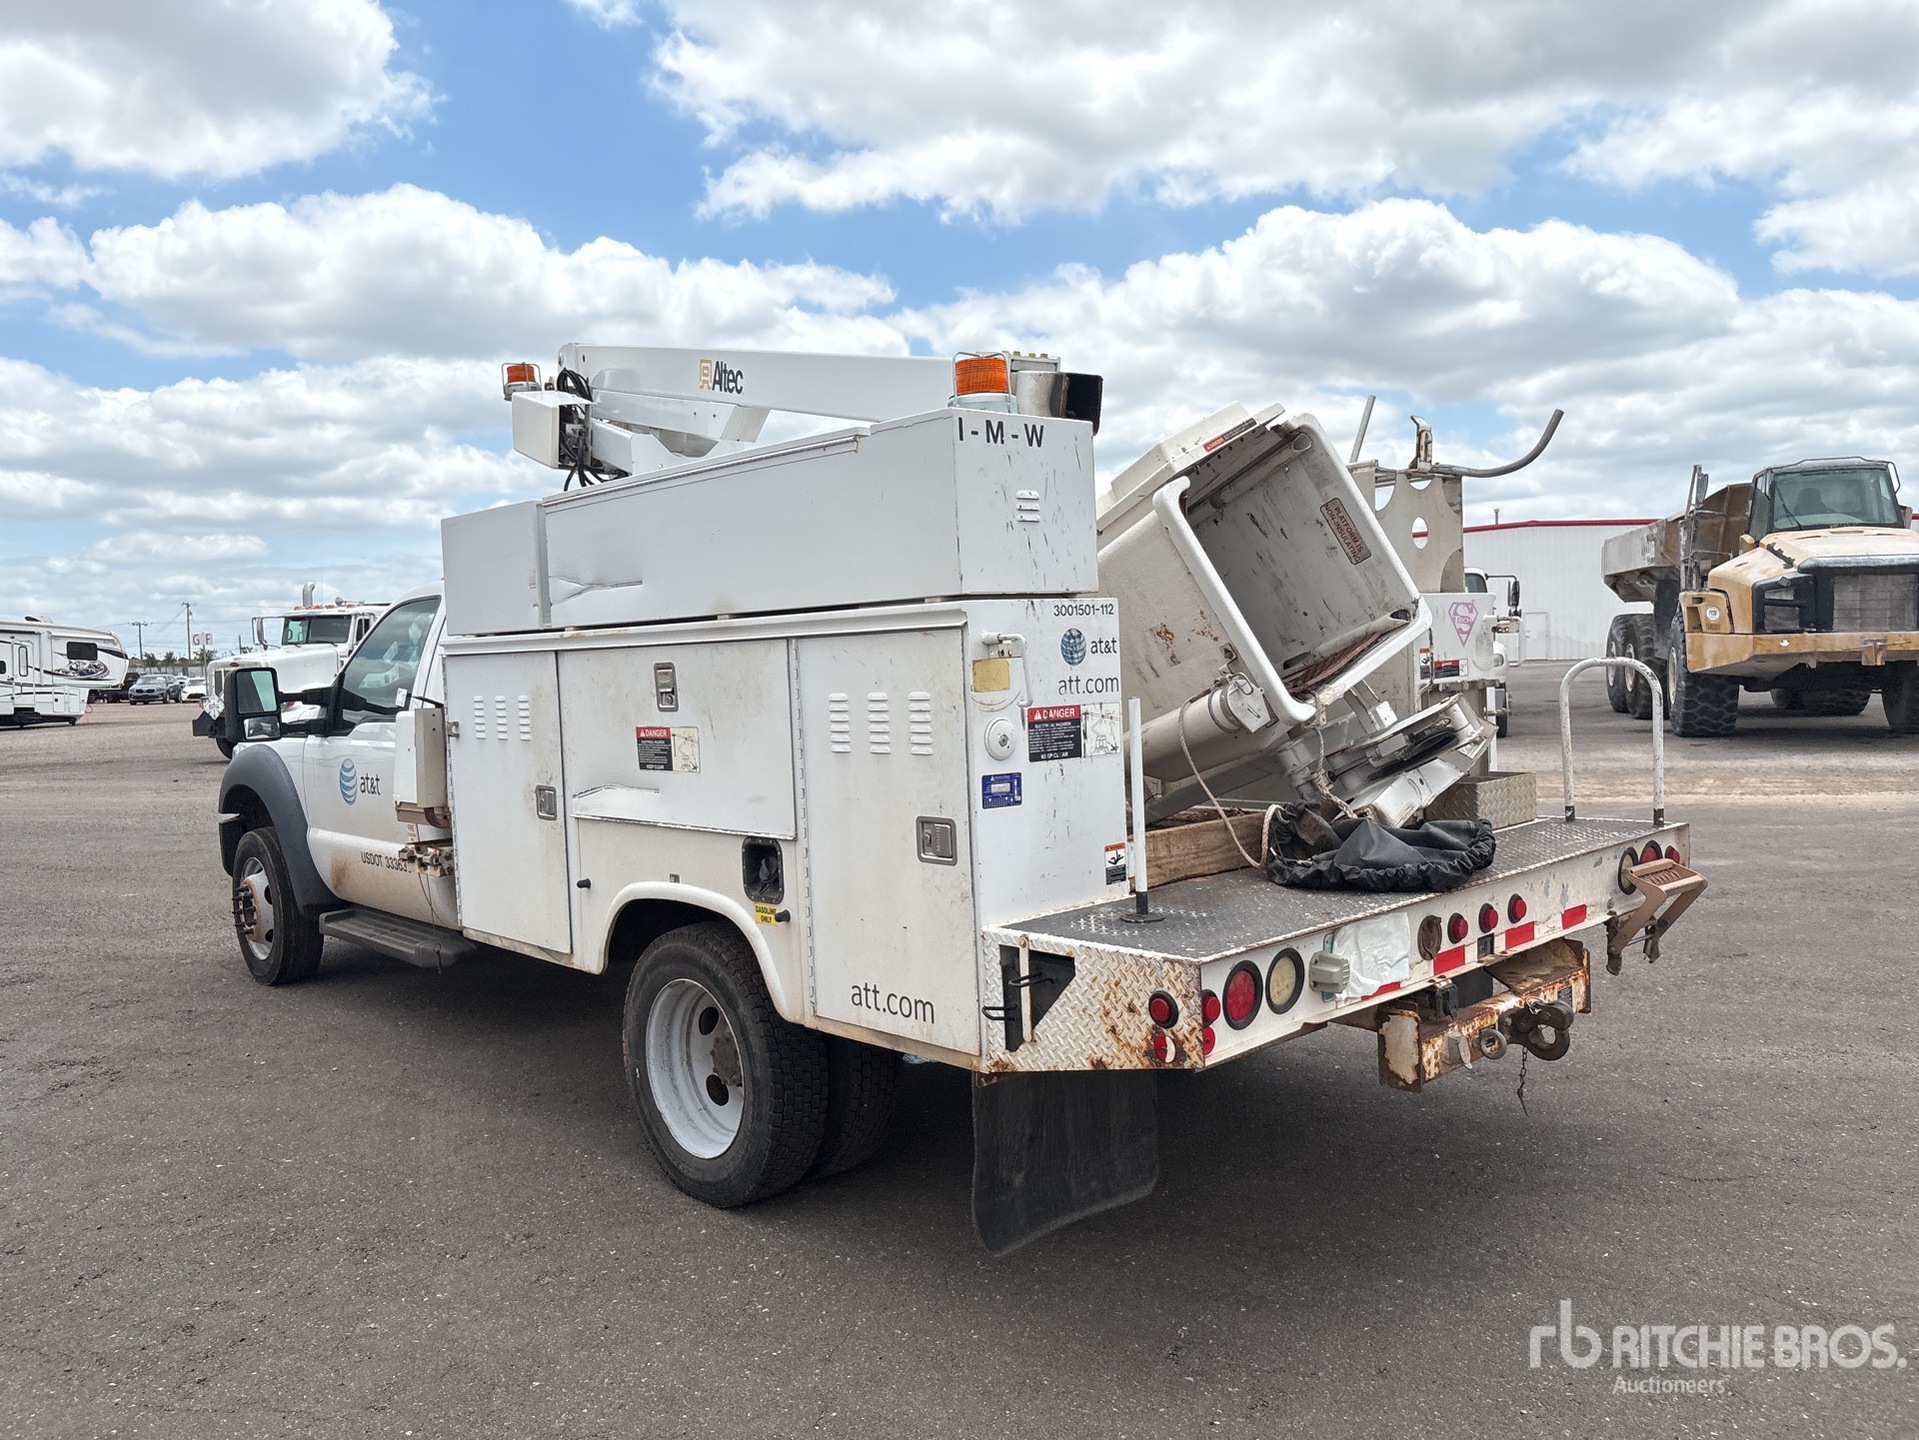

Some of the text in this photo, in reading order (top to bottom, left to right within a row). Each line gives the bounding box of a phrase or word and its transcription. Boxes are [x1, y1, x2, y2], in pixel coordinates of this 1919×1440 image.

[711, 360, 744, 395] Altec
[1334, 506, 1364, 553] PLATFORM IS
[1053, 603, 1114, 617] 3001501-112
[1090, 637, 1117, 655] at&t
[1058, 675, 1119, 696] att.com
[1042, 707, 1076, 720] DANGER
[645, 728, 668, 738] DANGER
[360, 772, 381, 796] at&t
[361, 850, 383, 868] USDOT
[755, 905, 777, 916] GASOLINE
[760, 915, 773, 924] ONLY
[851, 982, 935, 1025] att.com
